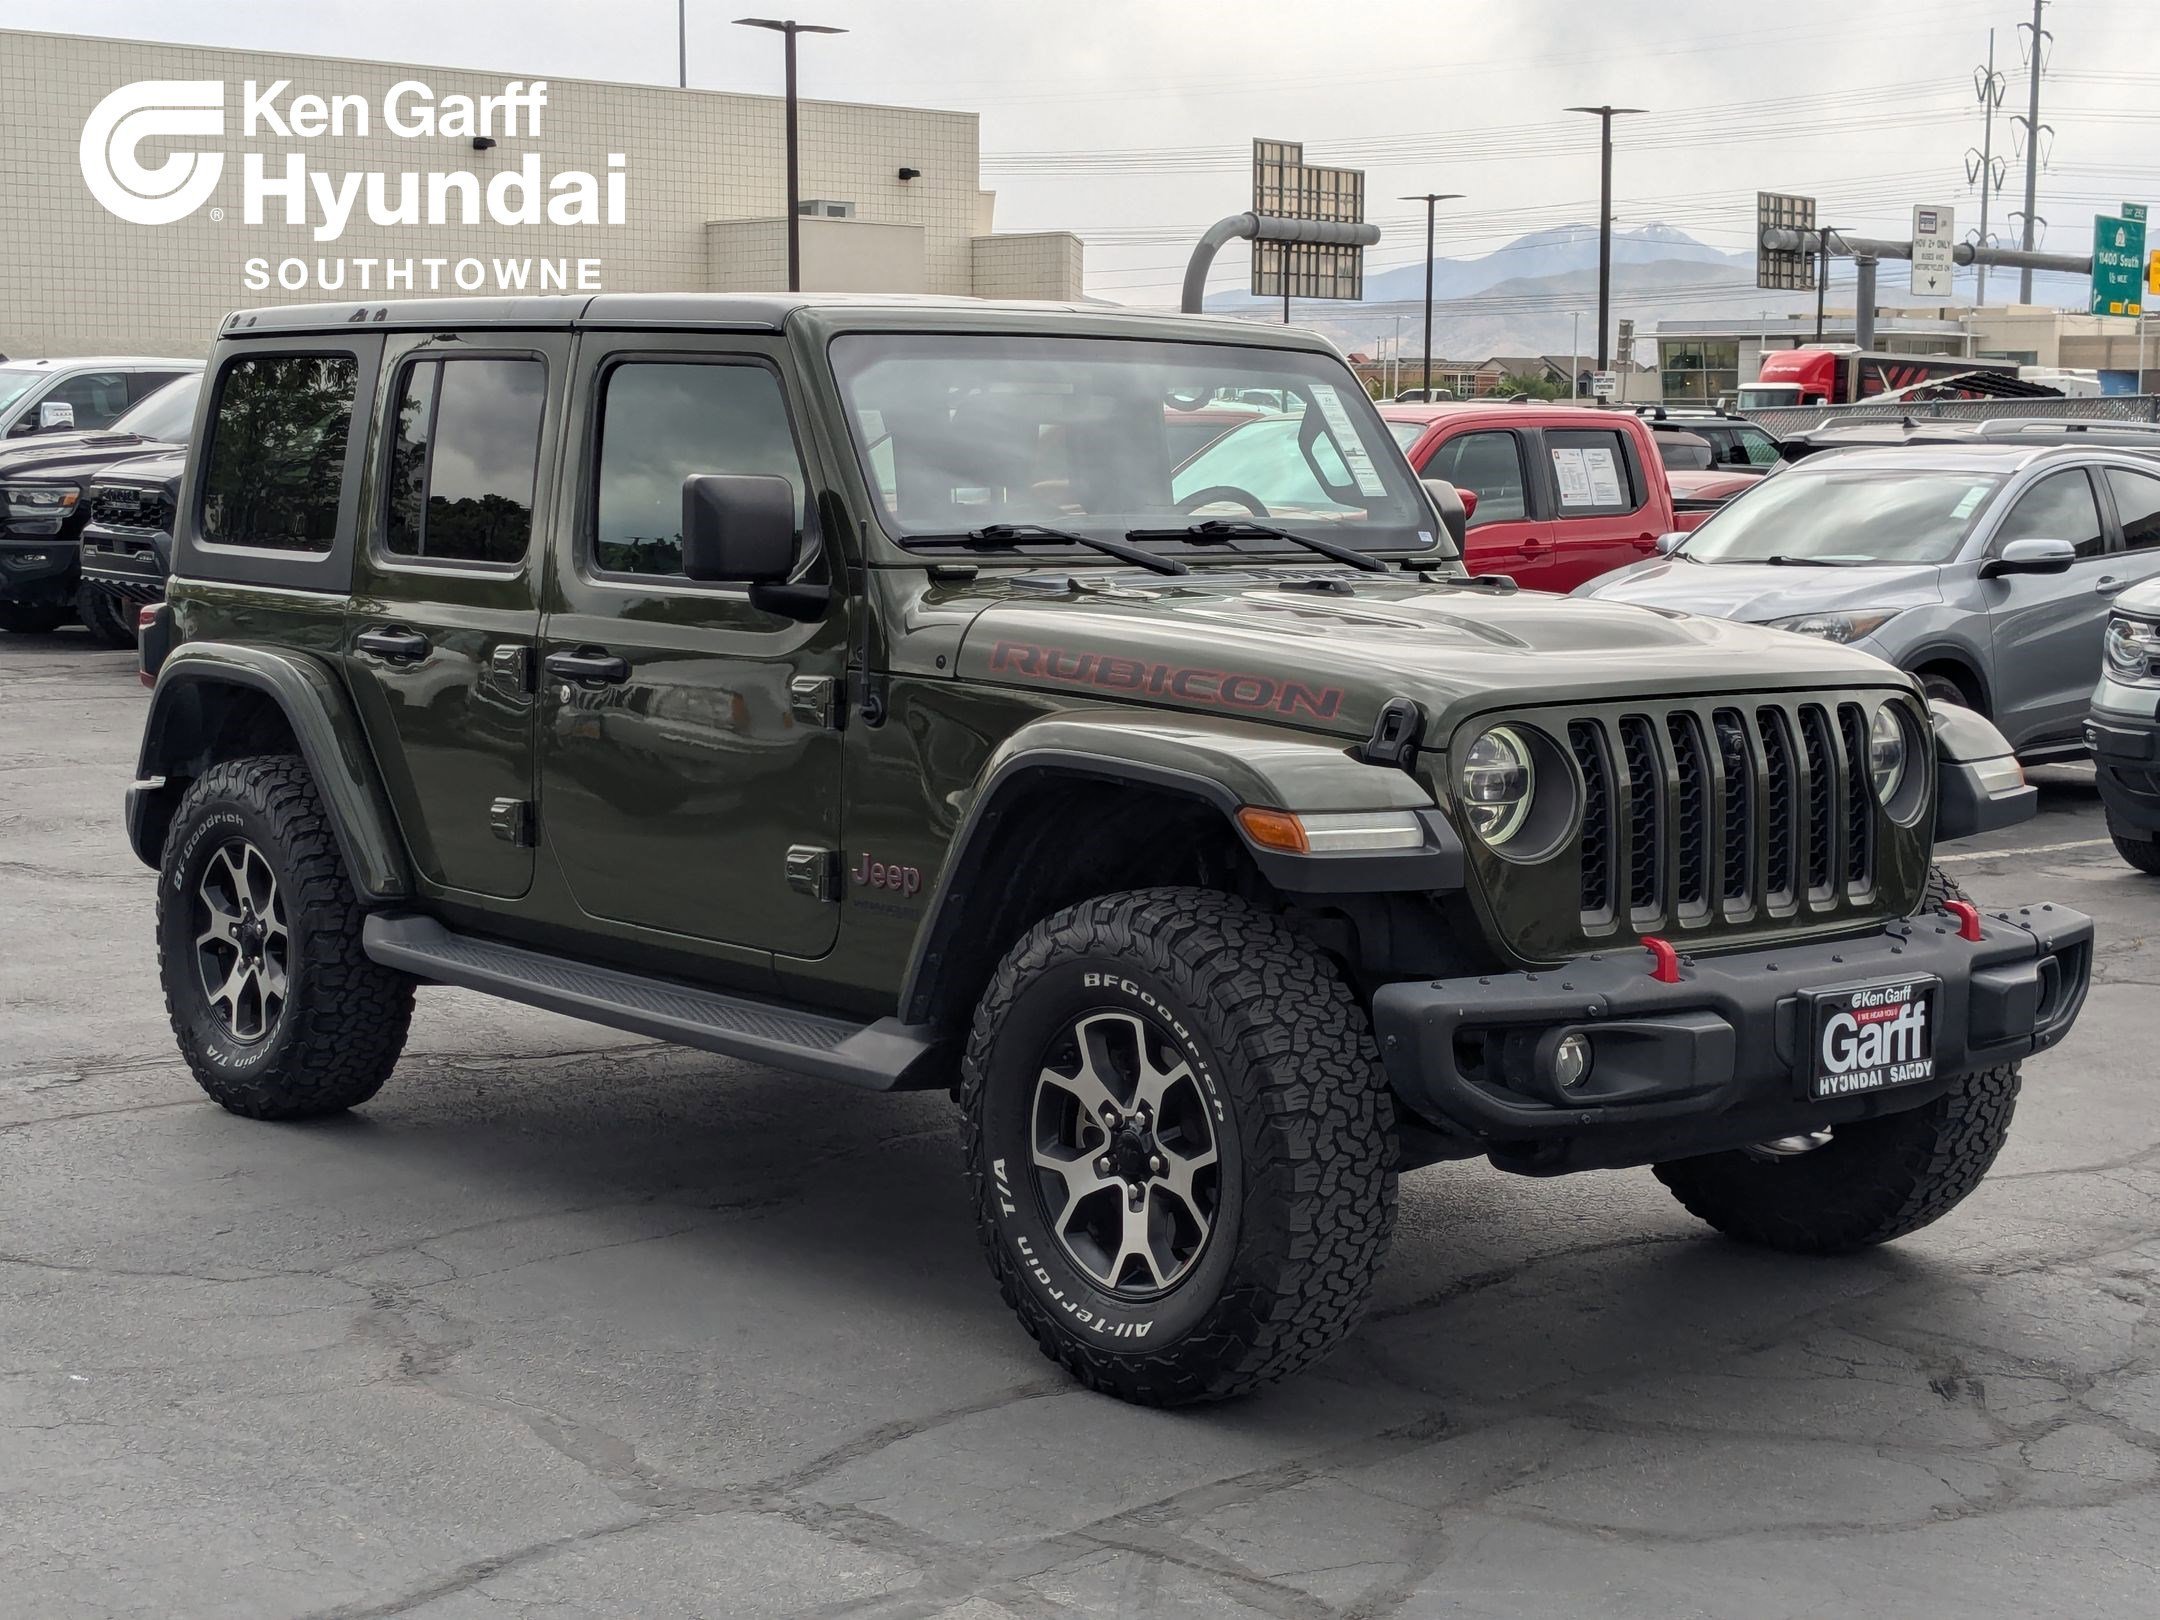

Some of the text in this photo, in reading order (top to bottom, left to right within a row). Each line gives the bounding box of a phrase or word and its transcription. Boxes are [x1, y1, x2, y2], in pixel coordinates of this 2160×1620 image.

[2120, 255, 2139, 268] South
[989, 640, 1346, 719] RUBICON
[174, 811, 244, 891] BFGoodrich
[851, 852, 921, 898] Jeep
[1861, 985, 1911, 1007] Ken Garff
[206, 1044, 229, 1067] T/A
[1084, 972, 1224, 1122] BFGoodrich
[1822, 1000, 1925, 1073] Garff
[1819, 1061, 1933, 1095] HYUNDAI SANDY
[993, 1159, 1154, 1338] All-Terrain T/A
